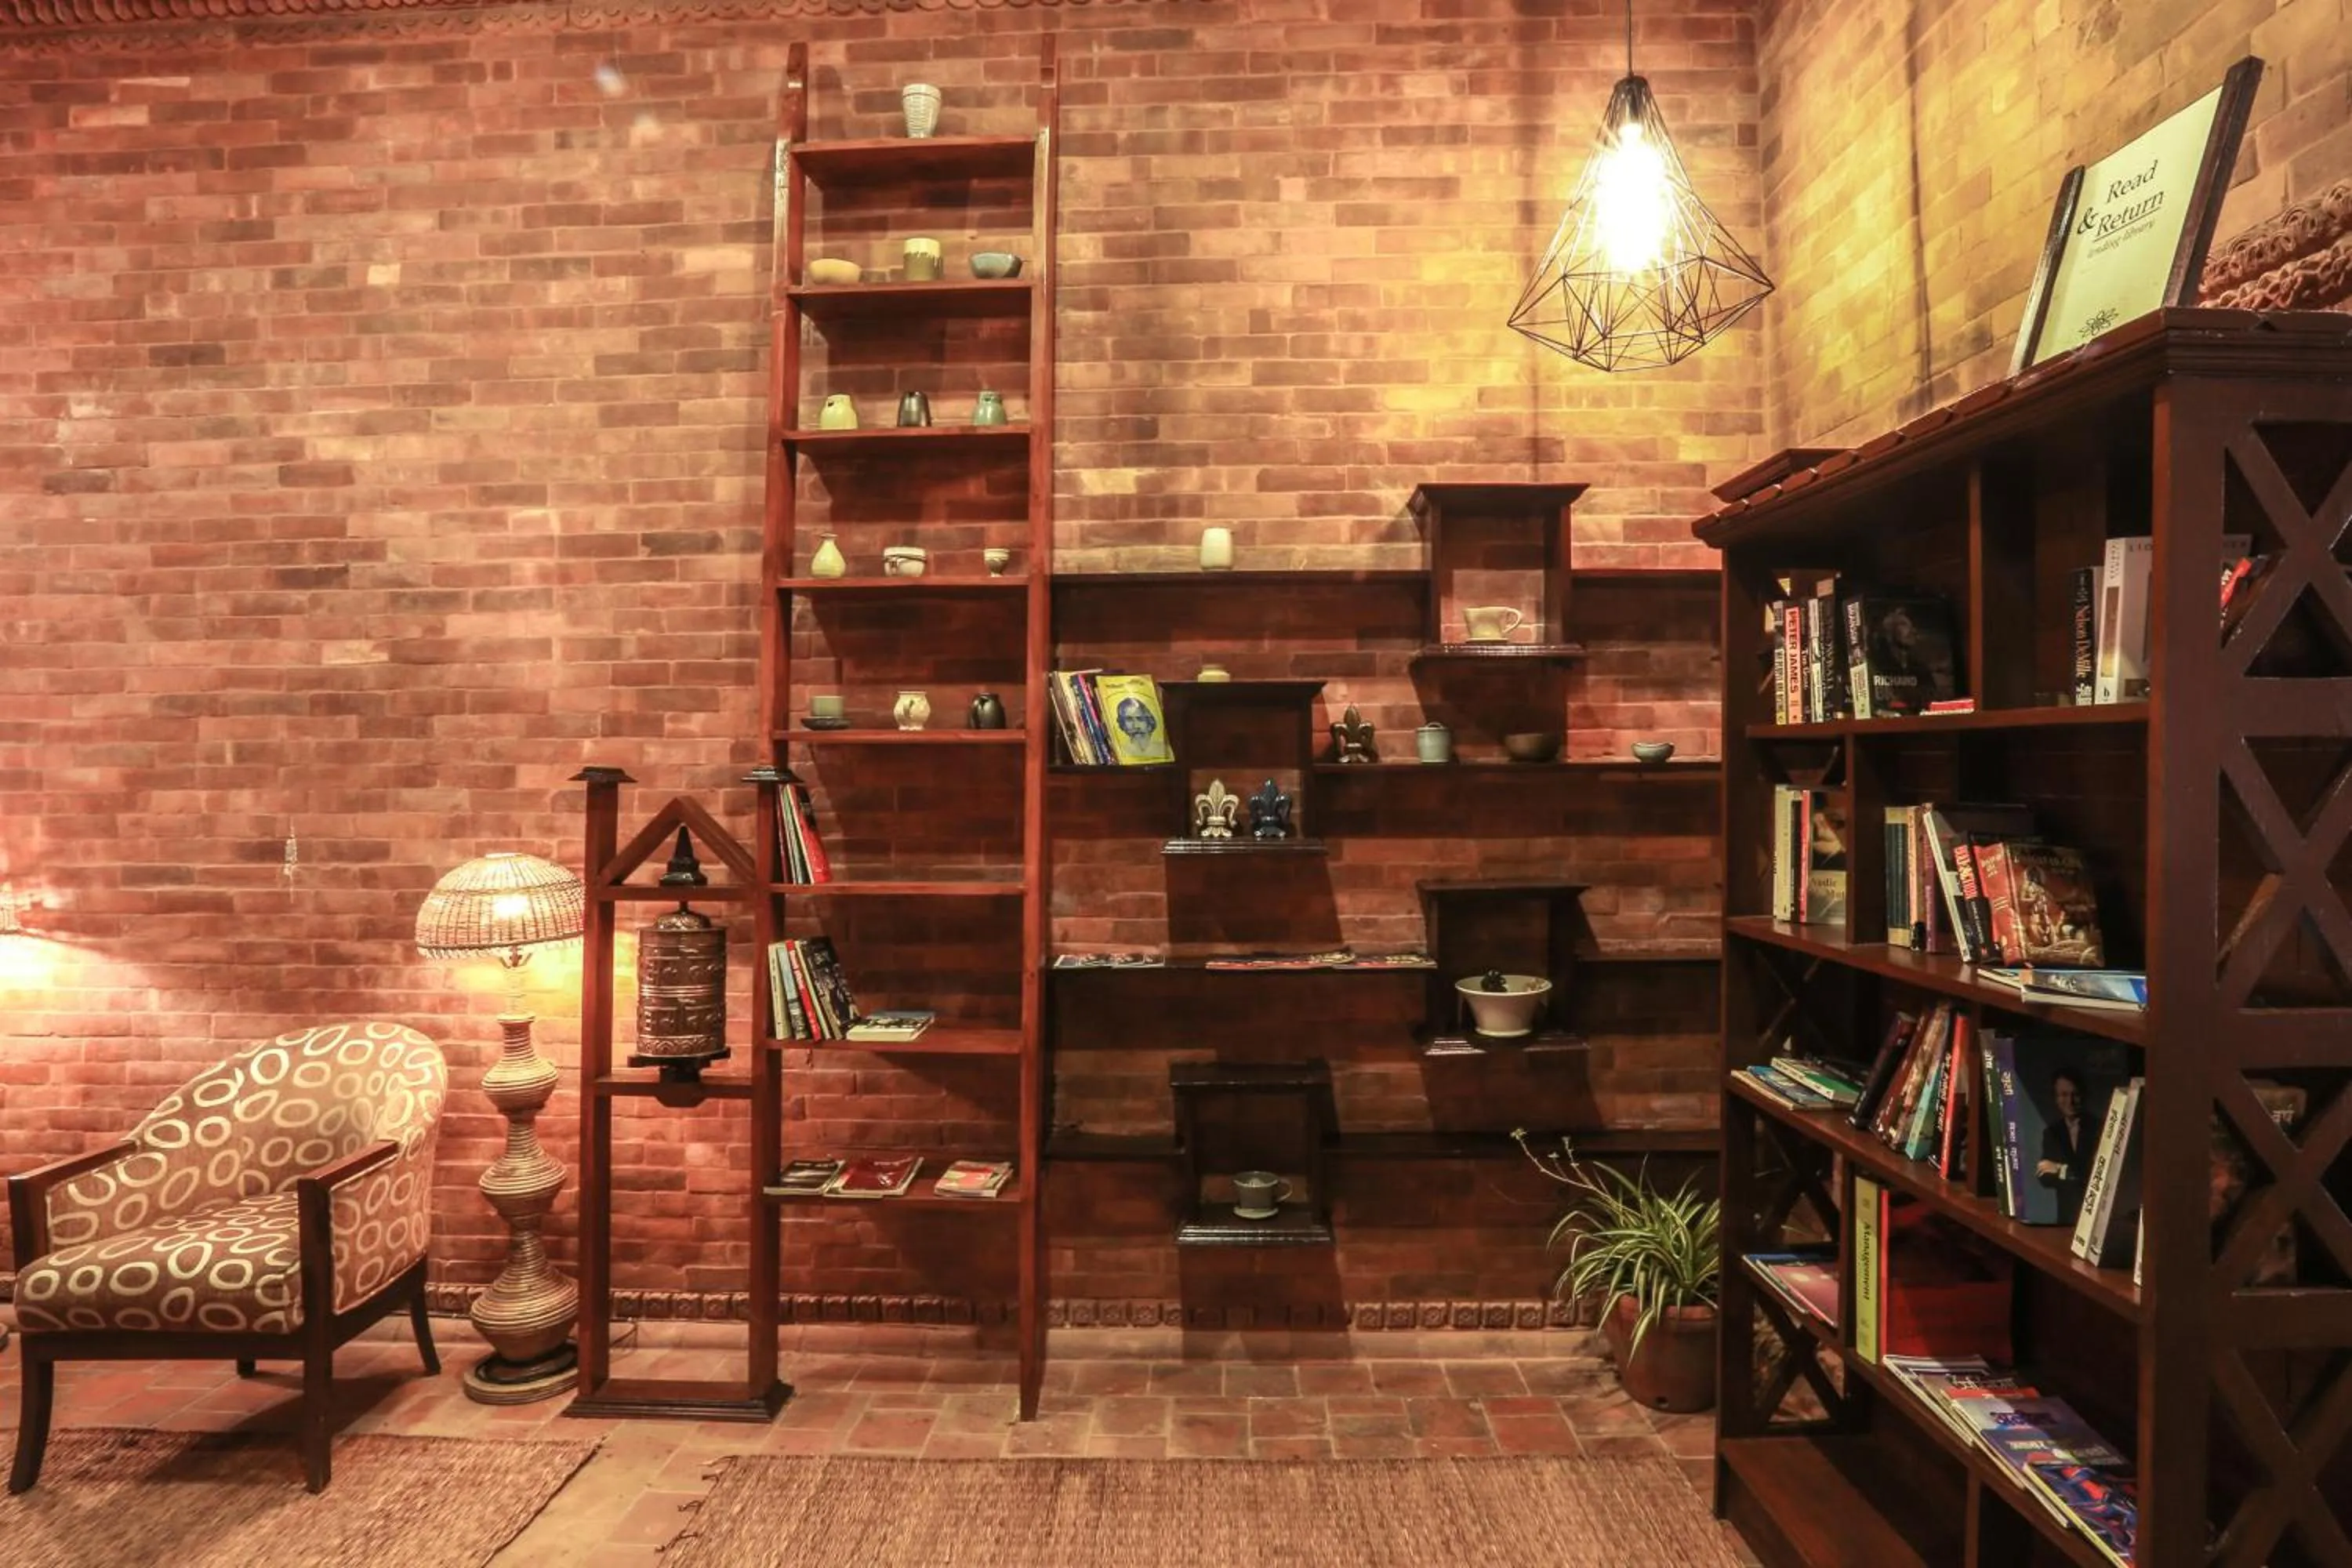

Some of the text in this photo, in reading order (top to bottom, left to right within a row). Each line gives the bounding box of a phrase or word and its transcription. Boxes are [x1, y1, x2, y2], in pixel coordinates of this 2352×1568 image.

[2107, 159, 2158, 203] Read
[2077, 191, 2165, 237] & Return
[1788, 610, 1799, 694] PETER JAMES
